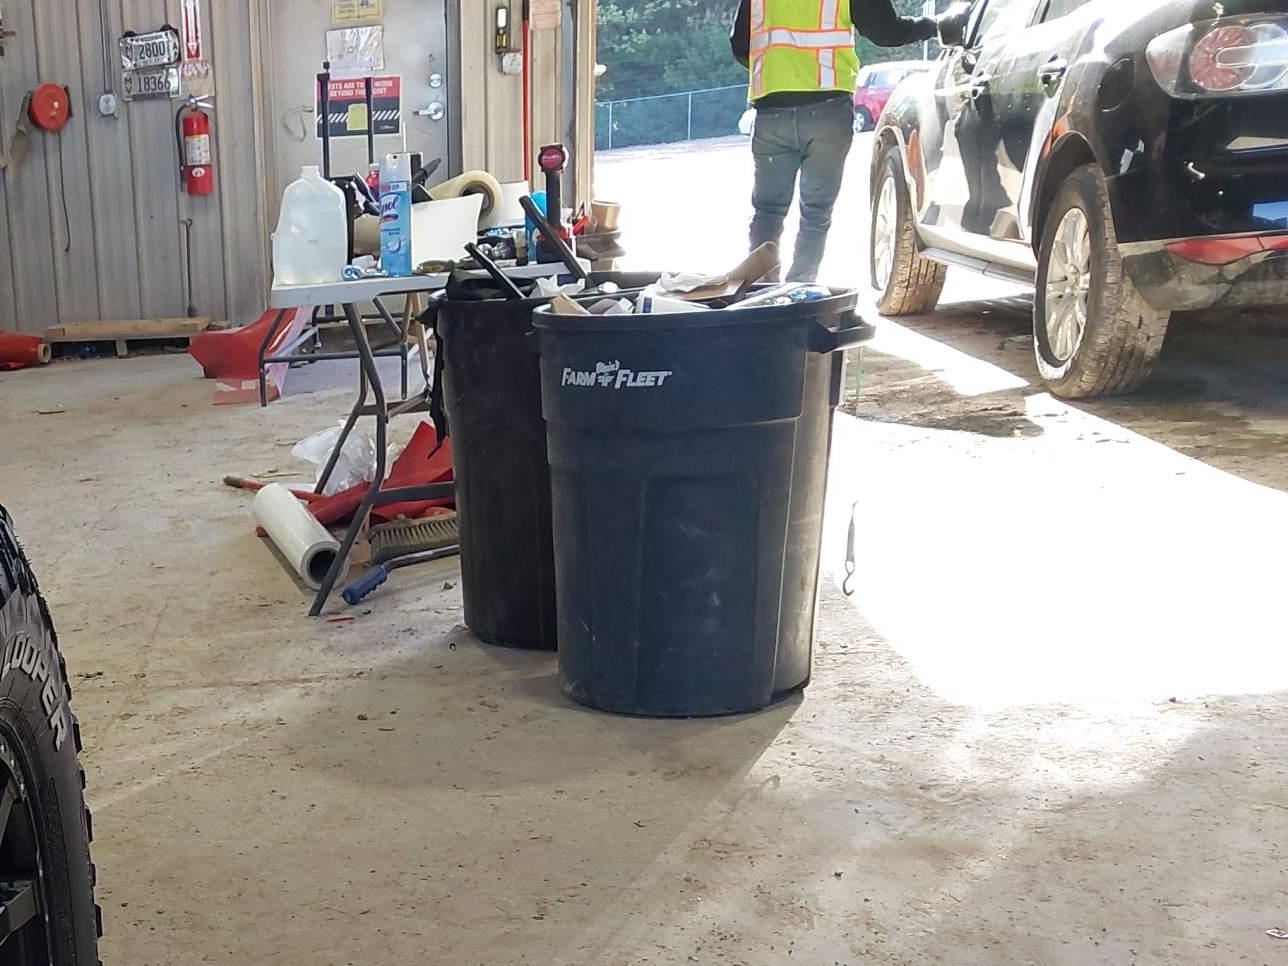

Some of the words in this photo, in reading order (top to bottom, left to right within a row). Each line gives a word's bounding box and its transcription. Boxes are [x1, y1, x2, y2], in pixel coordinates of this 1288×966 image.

[139, 41, 166, 59] 2800
[137, 76, 171, 92] 18366
[561, 367, 597, 386] FARM
